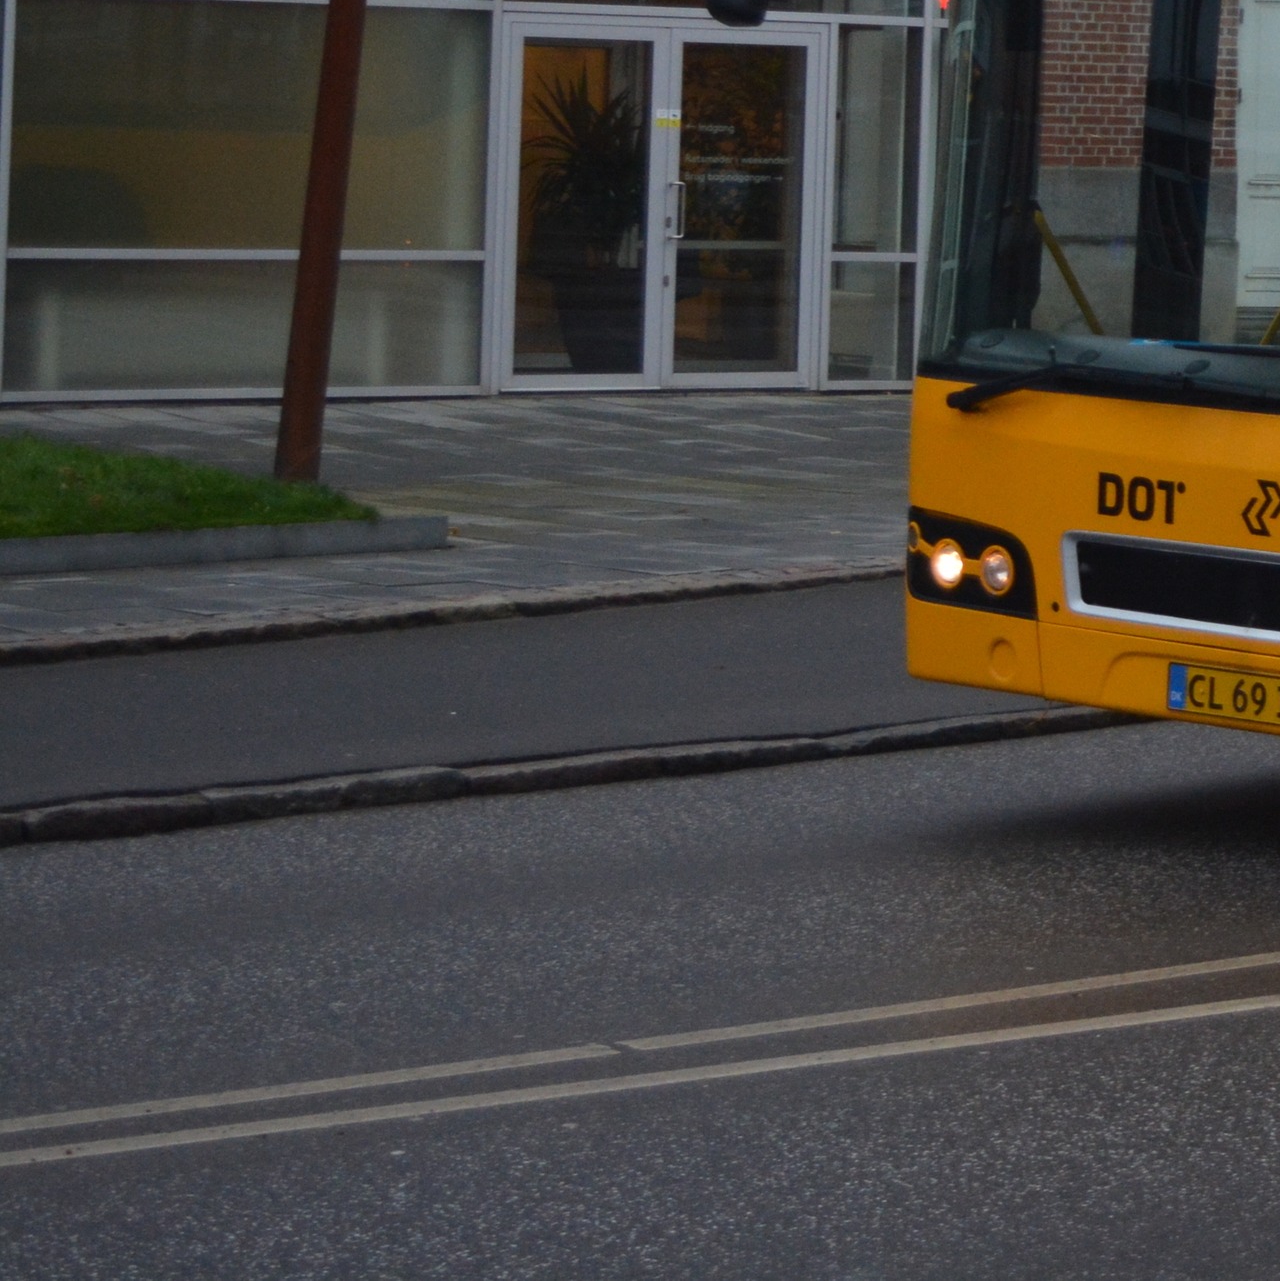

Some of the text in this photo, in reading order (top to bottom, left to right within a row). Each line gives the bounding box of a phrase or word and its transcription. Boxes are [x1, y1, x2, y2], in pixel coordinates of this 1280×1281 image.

[1097, 472, 1186, 525] DOT
[1189, 674, 1223, 710] CL
[1233, 679, 1267, 716] 69
